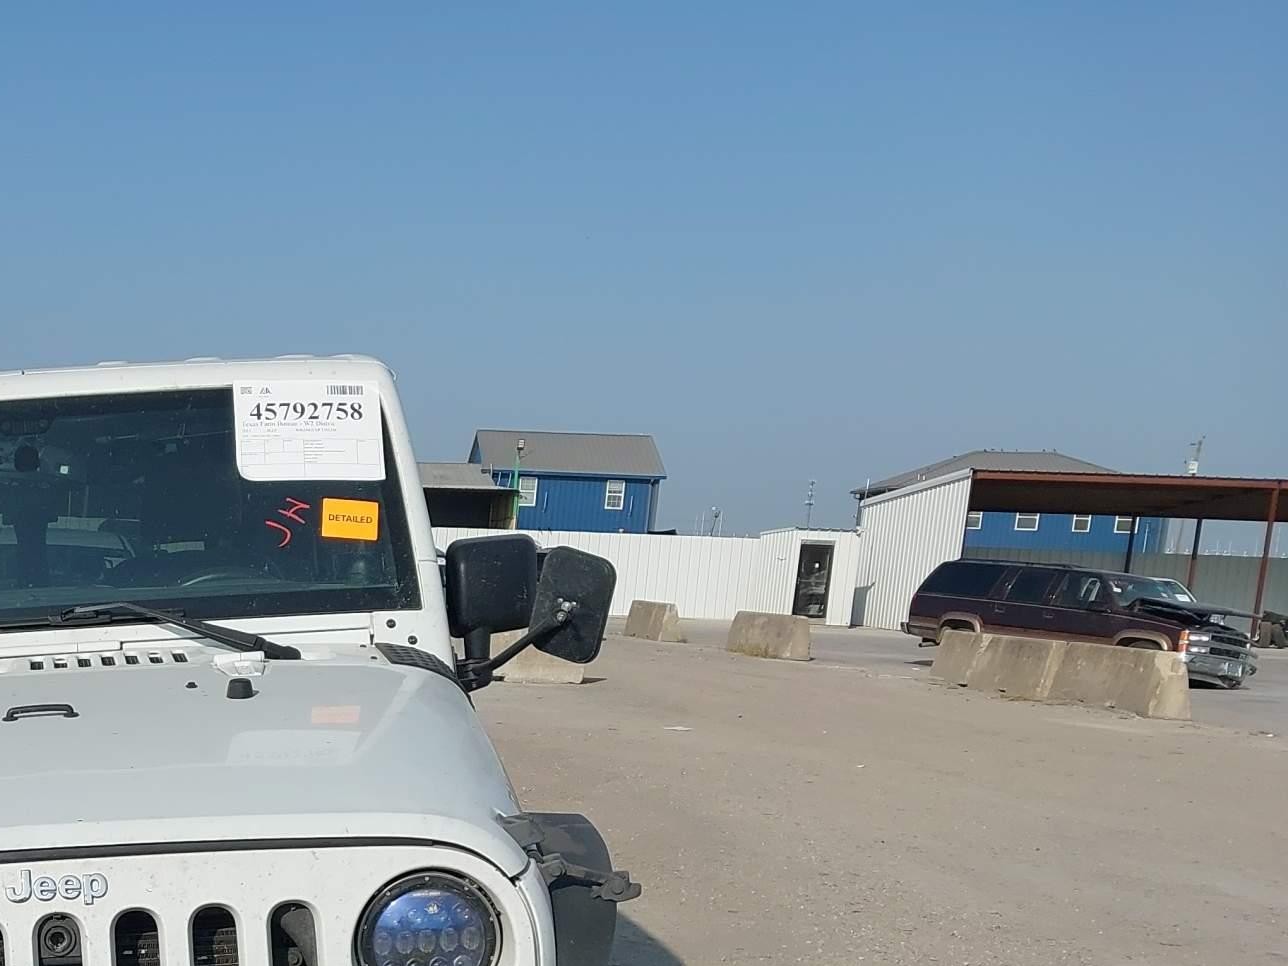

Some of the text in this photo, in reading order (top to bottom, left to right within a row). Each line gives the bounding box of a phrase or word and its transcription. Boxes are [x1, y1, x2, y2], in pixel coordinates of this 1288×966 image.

[250, 402, 363, 421] 45792758
[328, 513, 373, 524] DETAILED
[5, 869, 108, 905] Jeep
